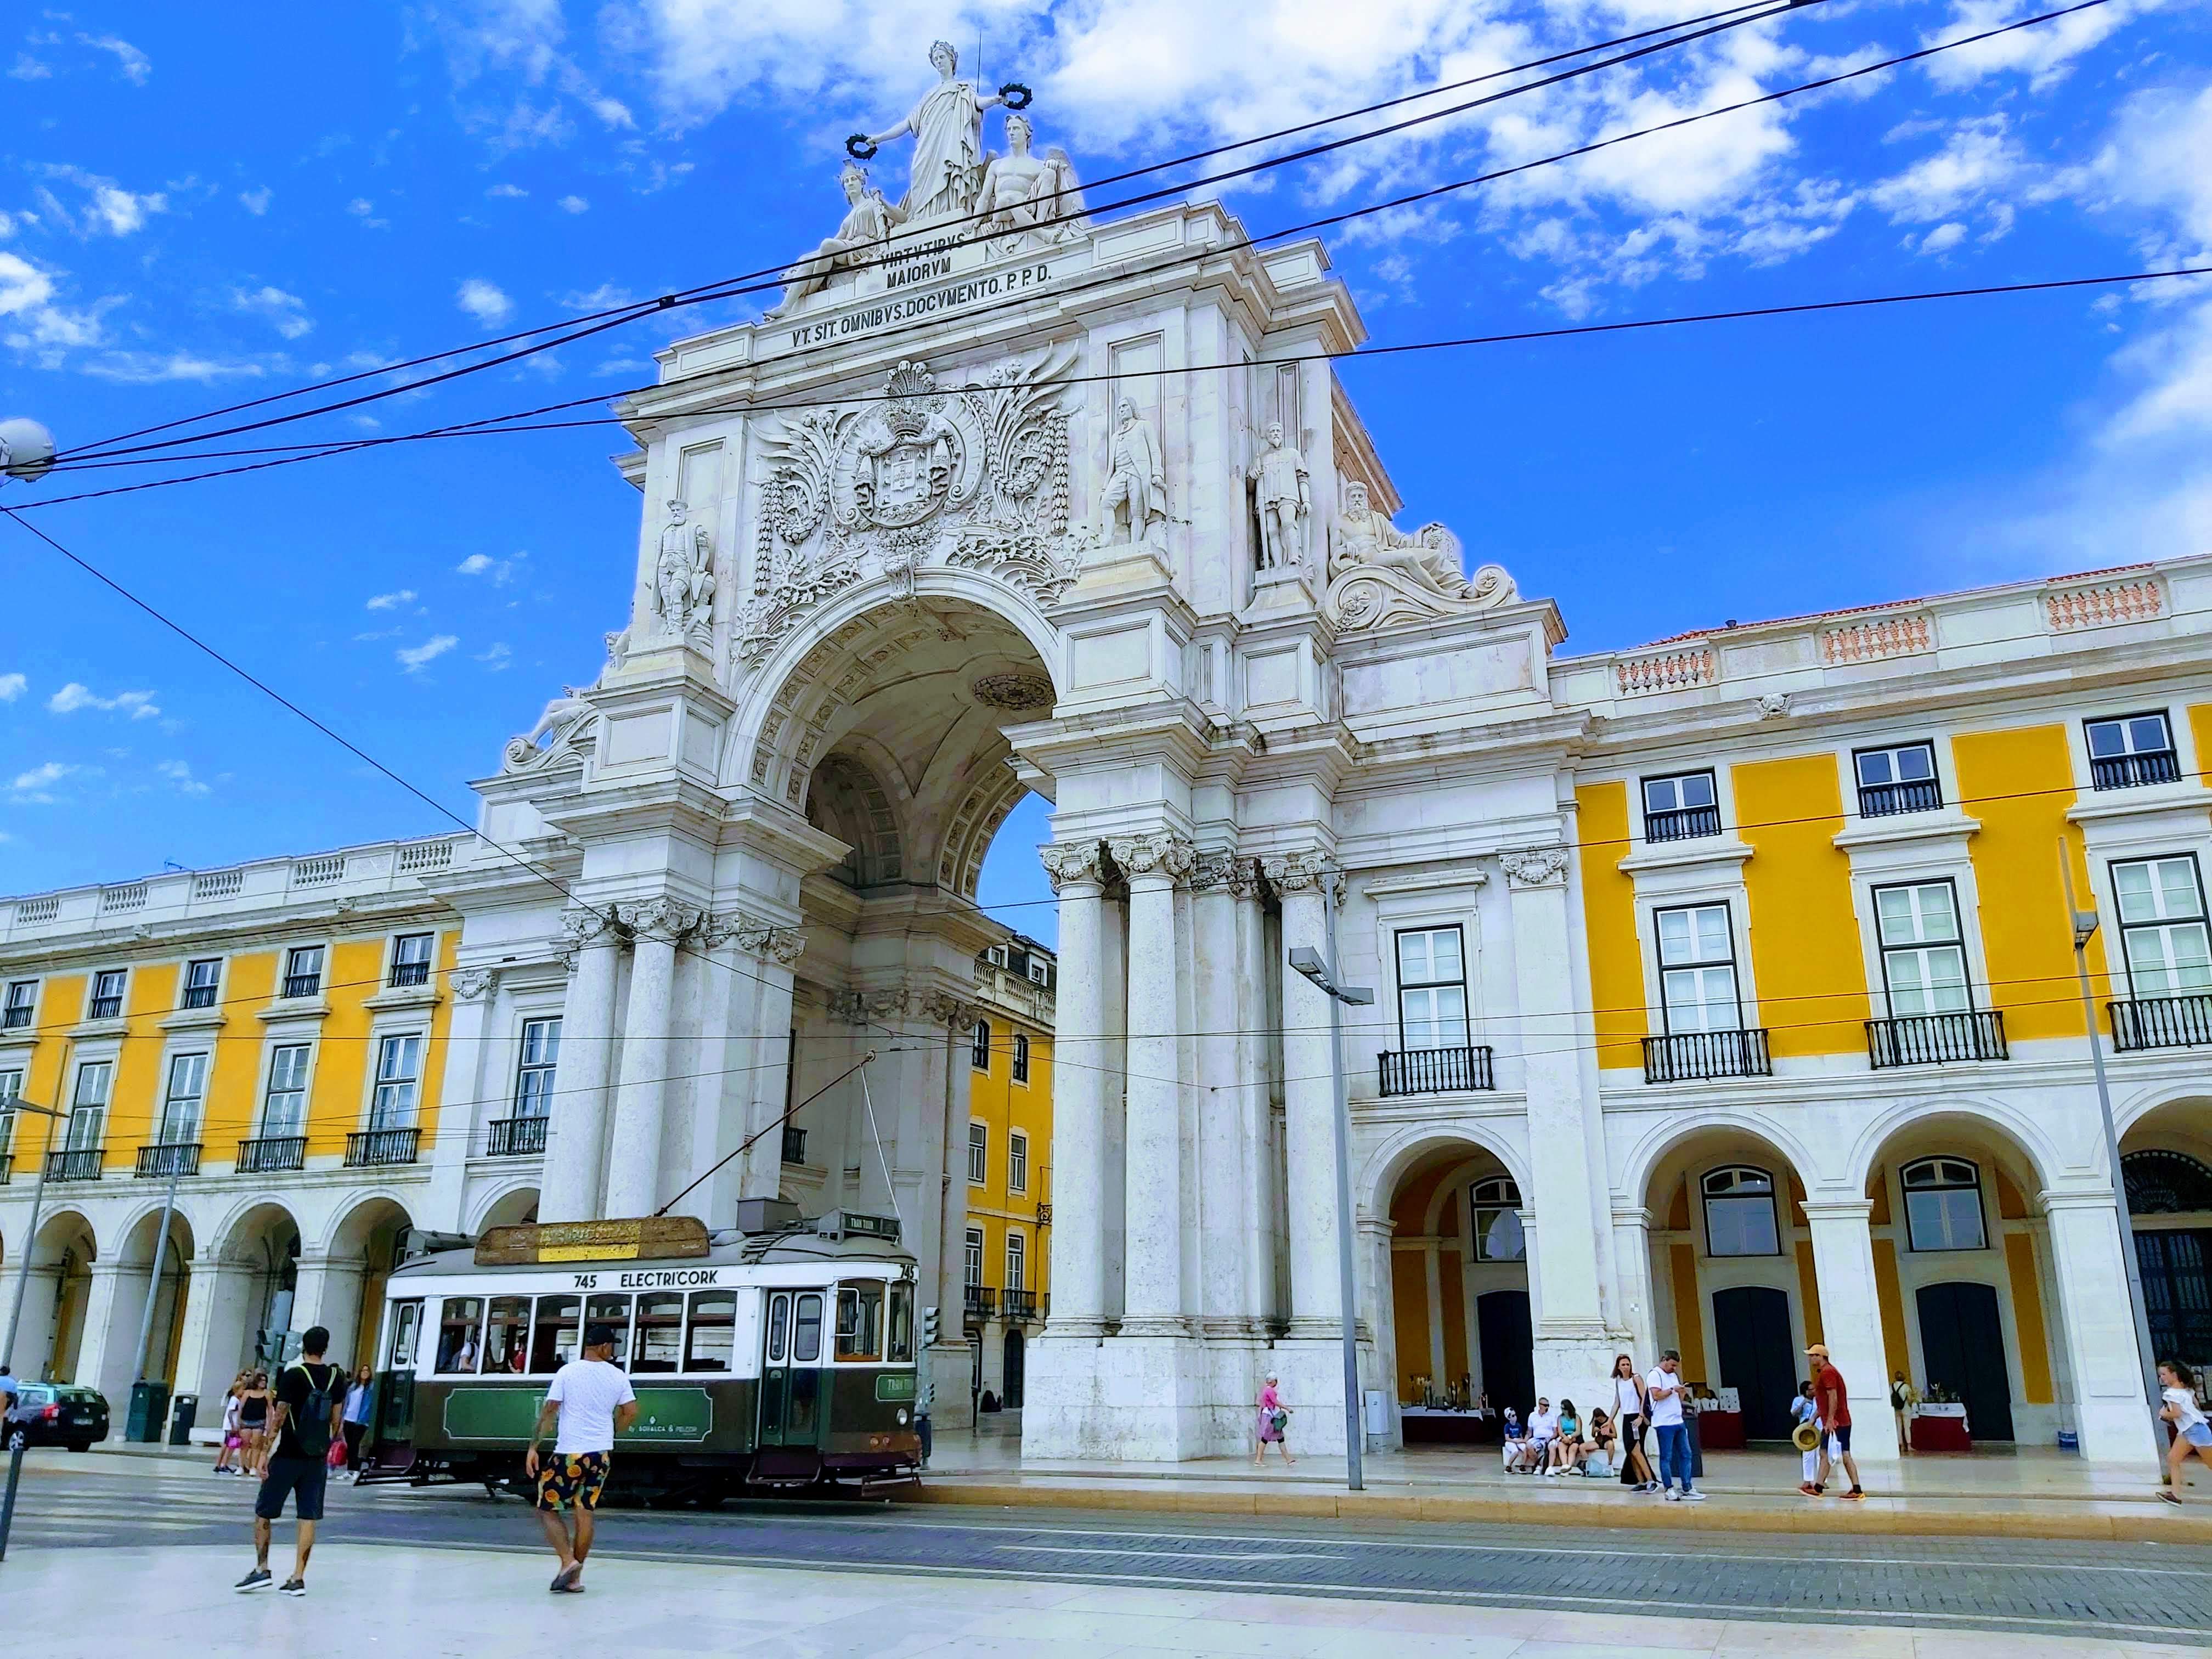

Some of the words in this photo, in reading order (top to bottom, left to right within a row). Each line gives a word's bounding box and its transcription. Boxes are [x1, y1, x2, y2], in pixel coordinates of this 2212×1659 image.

[887, 257, 951, 289] MAIORVM
[900, 1263, 914, 1280] 745
[574, 1274, 597, 1288] 745
